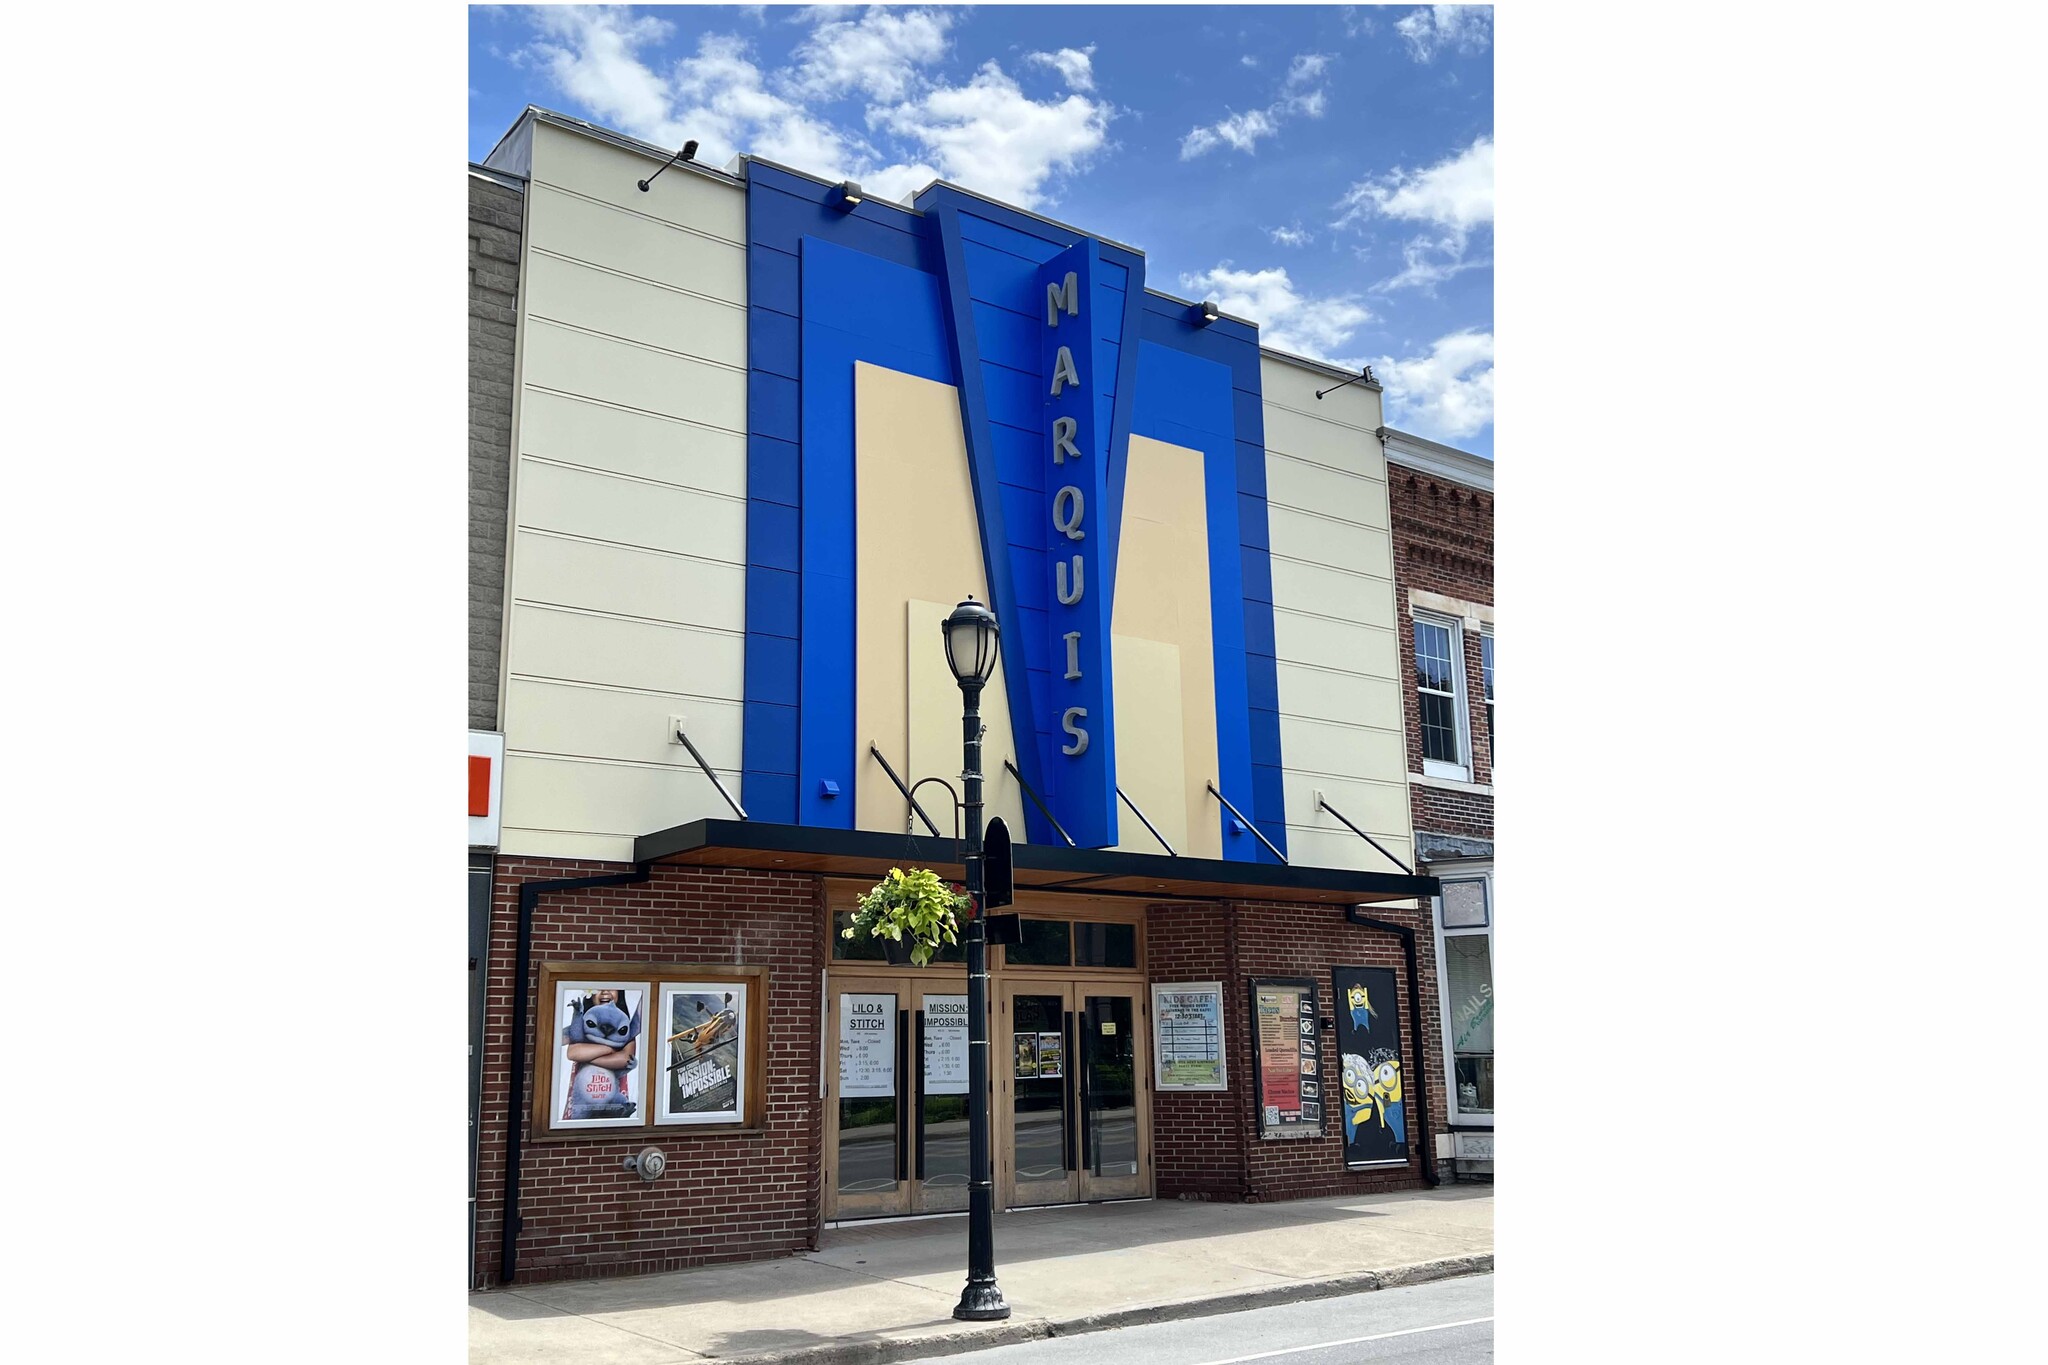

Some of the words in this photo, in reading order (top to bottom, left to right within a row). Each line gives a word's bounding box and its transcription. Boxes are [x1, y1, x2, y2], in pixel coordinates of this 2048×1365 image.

[1047, 271, 1089, 757] MARQUIS
[1164, 995, 1185, 1004] KIDS
[1186, 995, 1213, 1004] CAFE!
[851, 1003, 874, 1013] LILO
[876, 1003, 884, 1013] &
[1259, 1005, 1280, 1014] Tacos
[850, 1018, 885, 1029] STITCH
[678, 1060, 717, 1088] MISSION:
[682, 1064, 732, 1099] IMPOSSIBLE
[586, 1083, 612, 1092] STITCH
